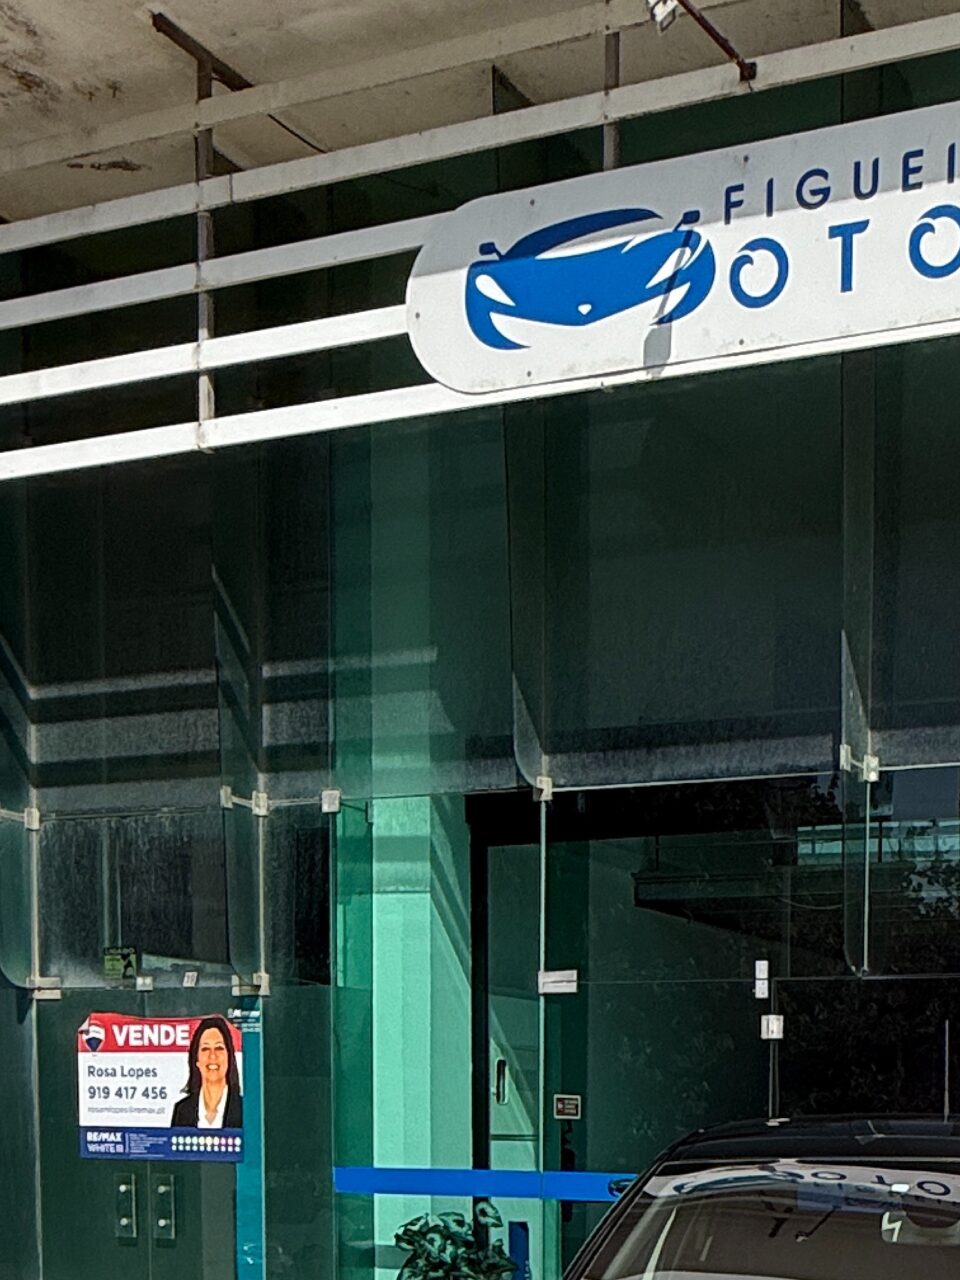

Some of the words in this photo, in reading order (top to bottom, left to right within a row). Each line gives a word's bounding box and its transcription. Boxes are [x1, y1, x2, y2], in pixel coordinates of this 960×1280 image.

[112, 1024, 190, 1046] VENDE
[87, 1065, 117, 1078] Rosa
[120, 1065, 158, 1080] Lopes
[88, 1085, 110, 1100] 919
[114, 1086, 138, 1100] 417
[141, 1086, 168, 1100] 456
